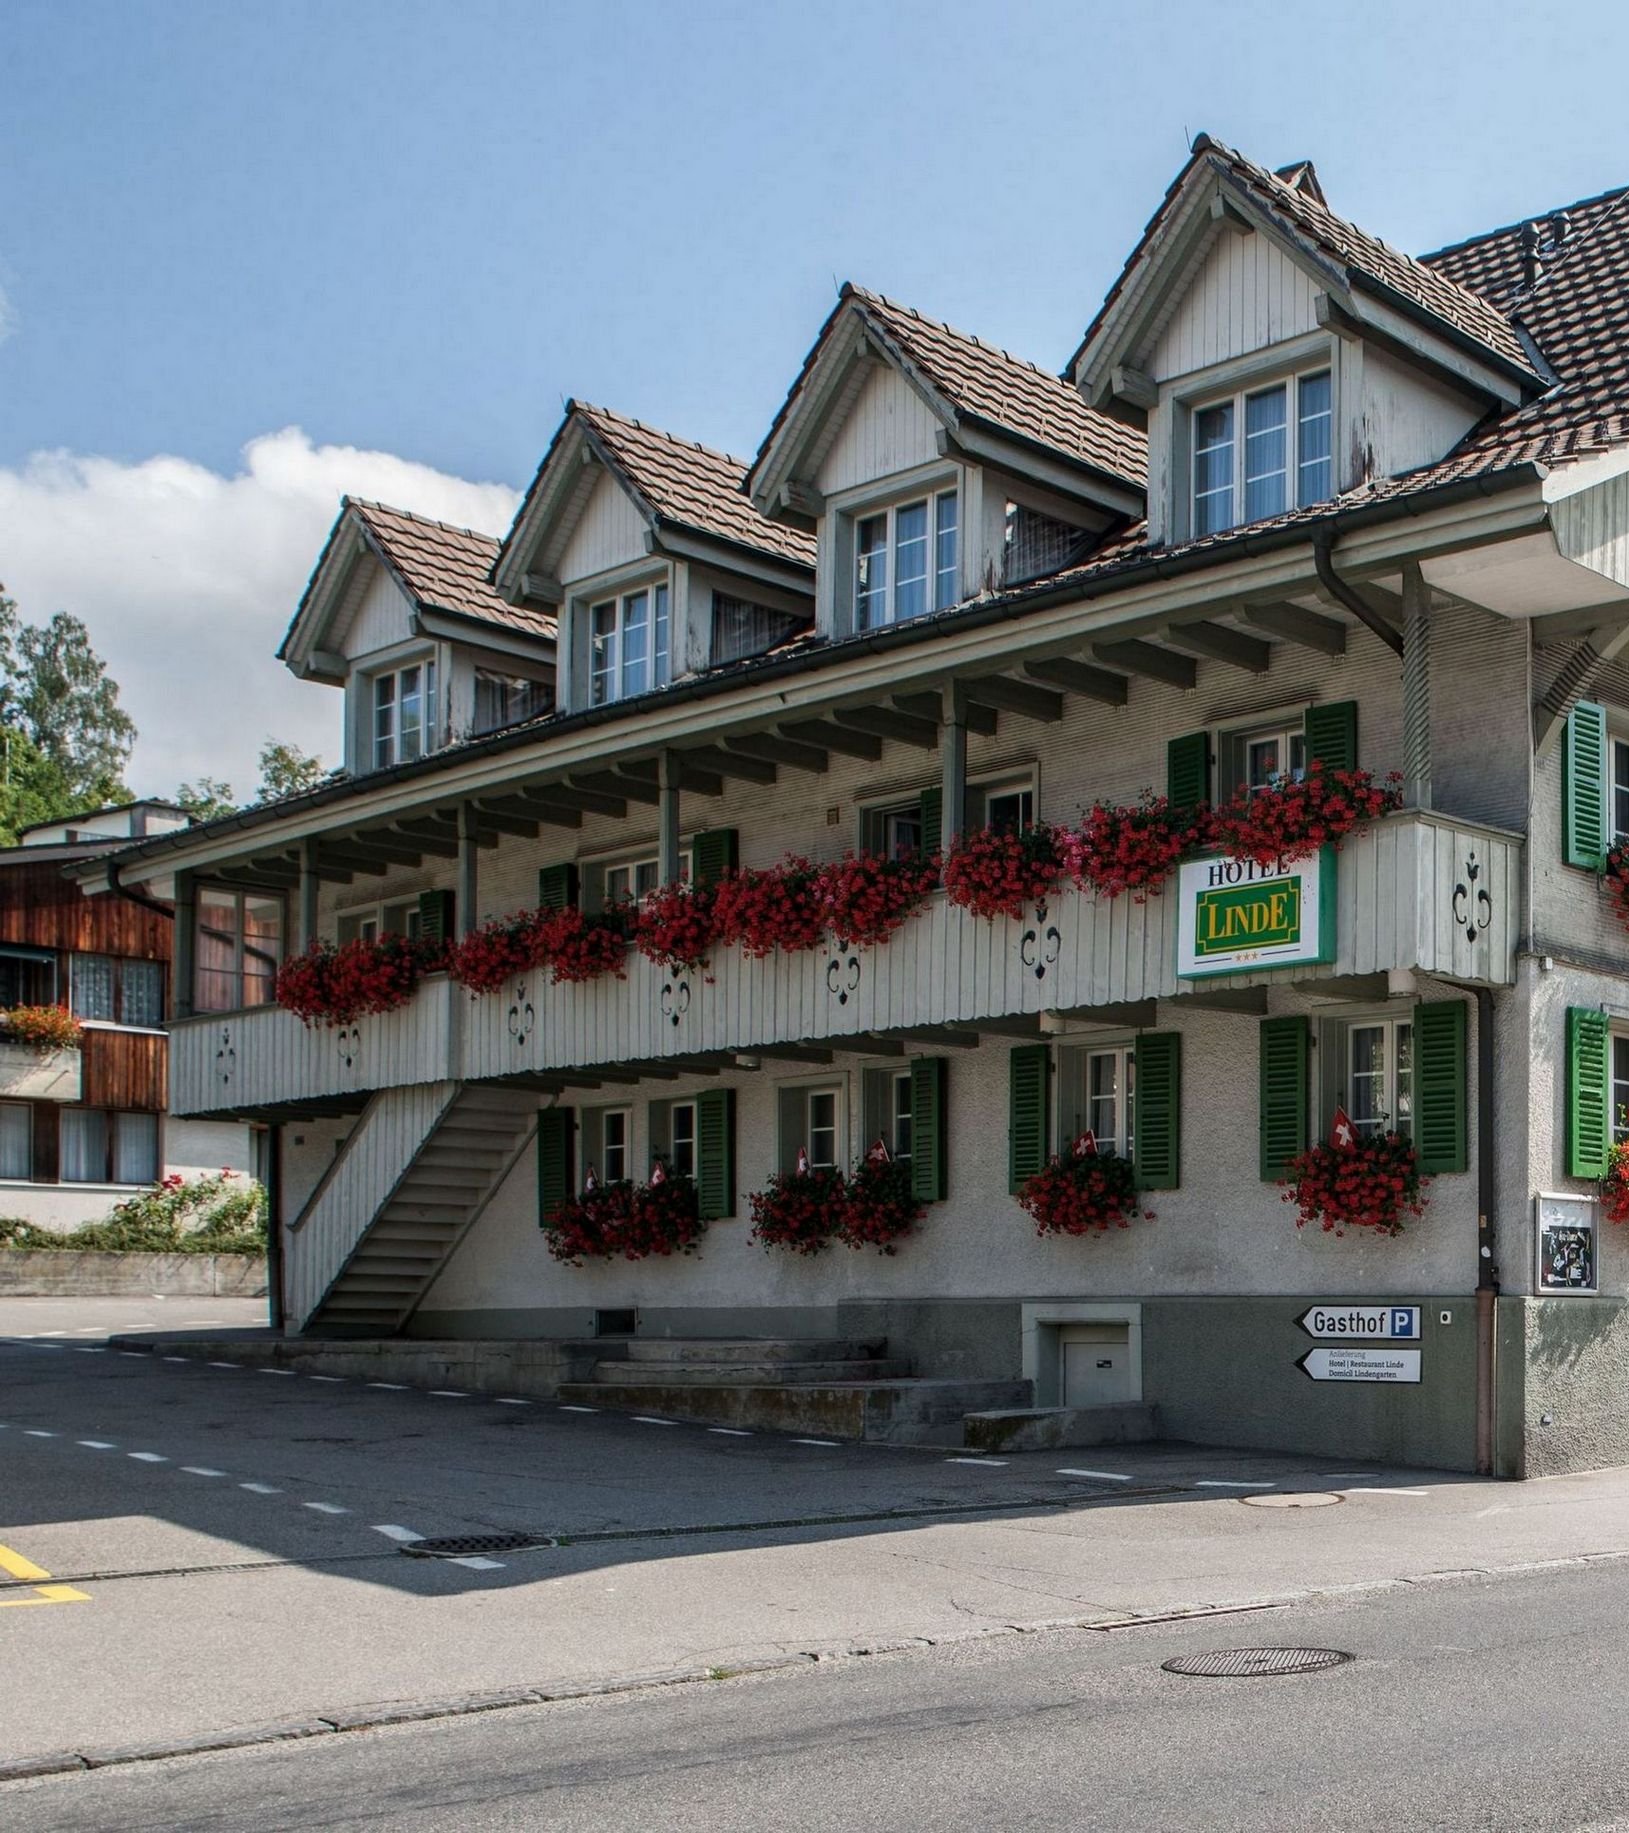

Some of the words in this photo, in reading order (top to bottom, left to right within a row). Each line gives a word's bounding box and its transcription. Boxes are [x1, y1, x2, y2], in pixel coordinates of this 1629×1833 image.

[1208, 854, 1291, 887] HOTEL
[1207, 893, 1288, 939] LINDE
[1314, 1311, 1386, 1333] Gasthof
[1394, 1312, 1409, 1334] P
[1350, 1360, 1385, 1368] Restaurant
[1355, 1370, 1397, 1379] Lindengarten
